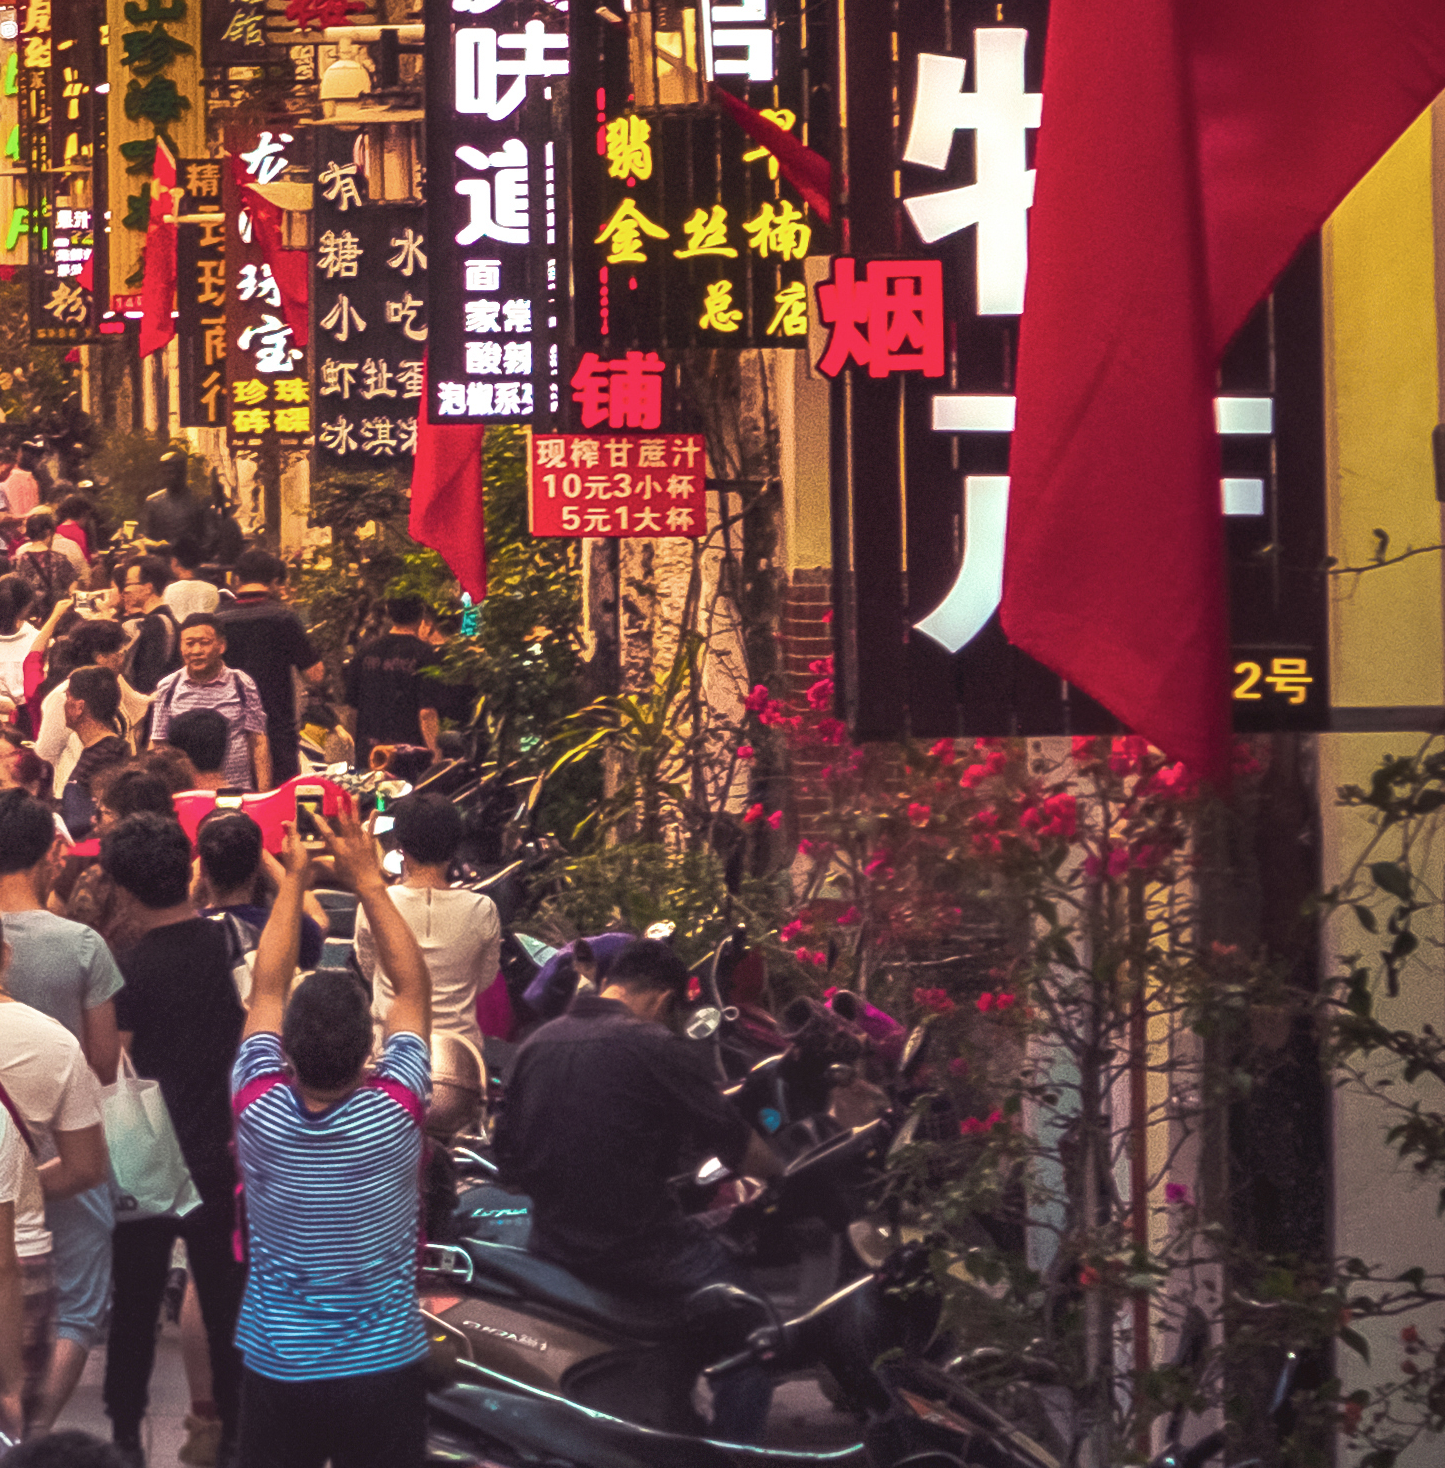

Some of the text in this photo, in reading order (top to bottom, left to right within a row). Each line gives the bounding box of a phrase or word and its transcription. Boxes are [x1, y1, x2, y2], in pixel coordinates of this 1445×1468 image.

[318, 229, 428, 278] 糖水
[595, 198, 811, 264] 金丝楠
[320, 292, 429, 342] 小吃
[699, 279, 808, 337] 总店
[818, 259, 945, 378] 烟
[232, 378, 309, 405] 珍珠
[571, 351, 665, 429] 铺
[537, 437, 701, 469] 现榨甘蔗汁
[542, 474, 695, 500] 10元3小杯
[562, 506, 695, 532] 5元1大杯
[1232, 659, 1314, 704] 2号
